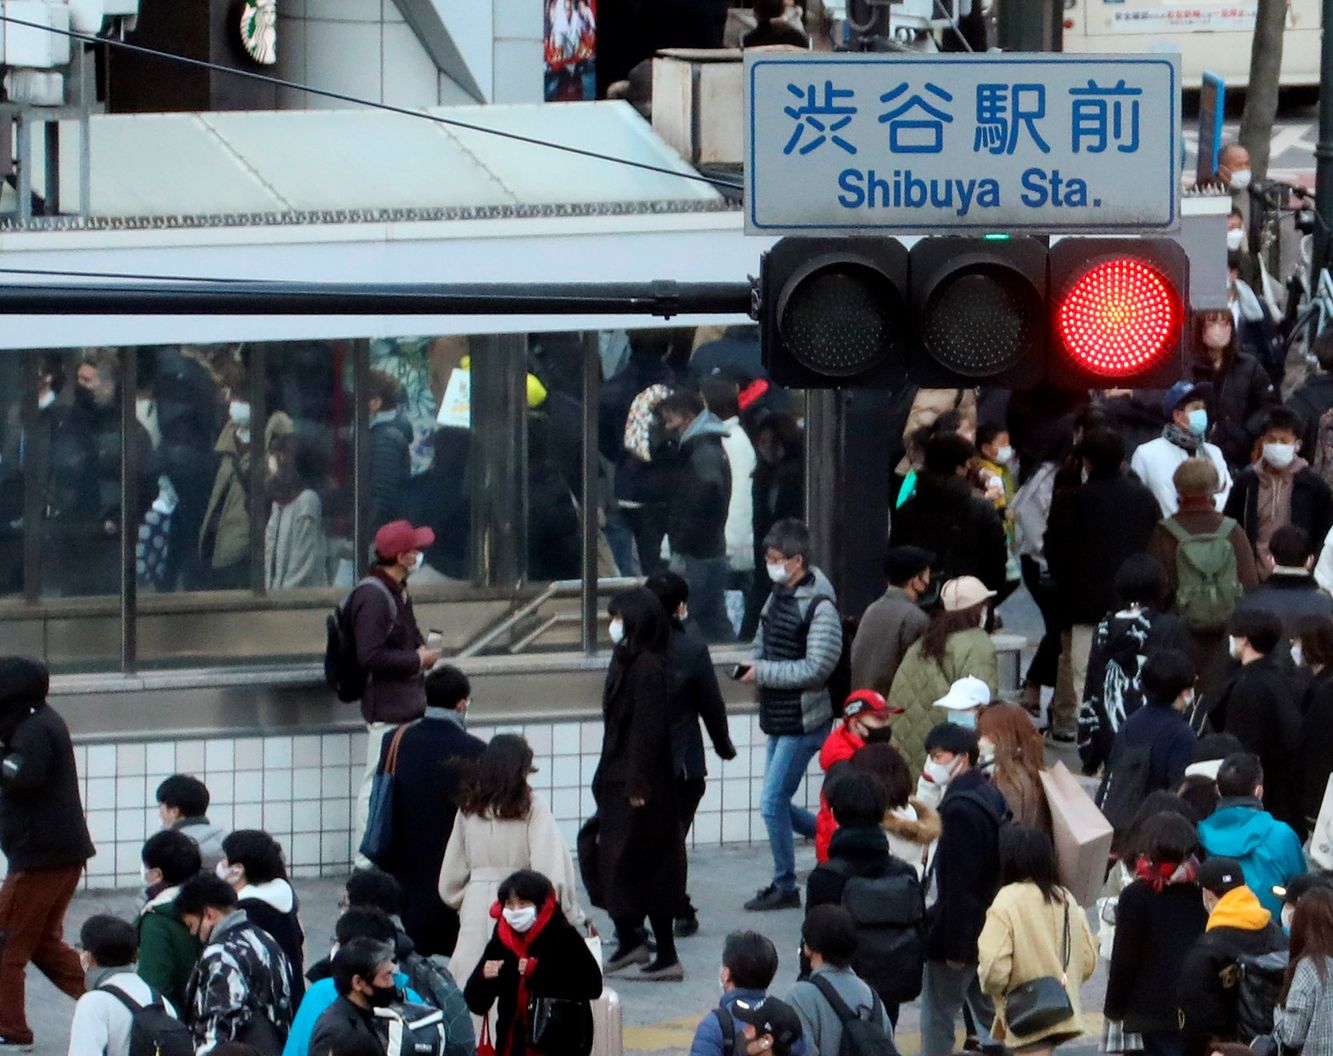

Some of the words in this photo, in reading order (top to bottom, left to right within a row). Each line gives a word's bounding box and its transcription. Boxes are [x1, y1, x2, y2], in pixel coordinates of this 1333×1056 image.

[783, 79, 1143, 155] 渋谷駅前
[838, 168, 1000, 217] Shibuya
[1021, 168, 1102, 208] Sta.
